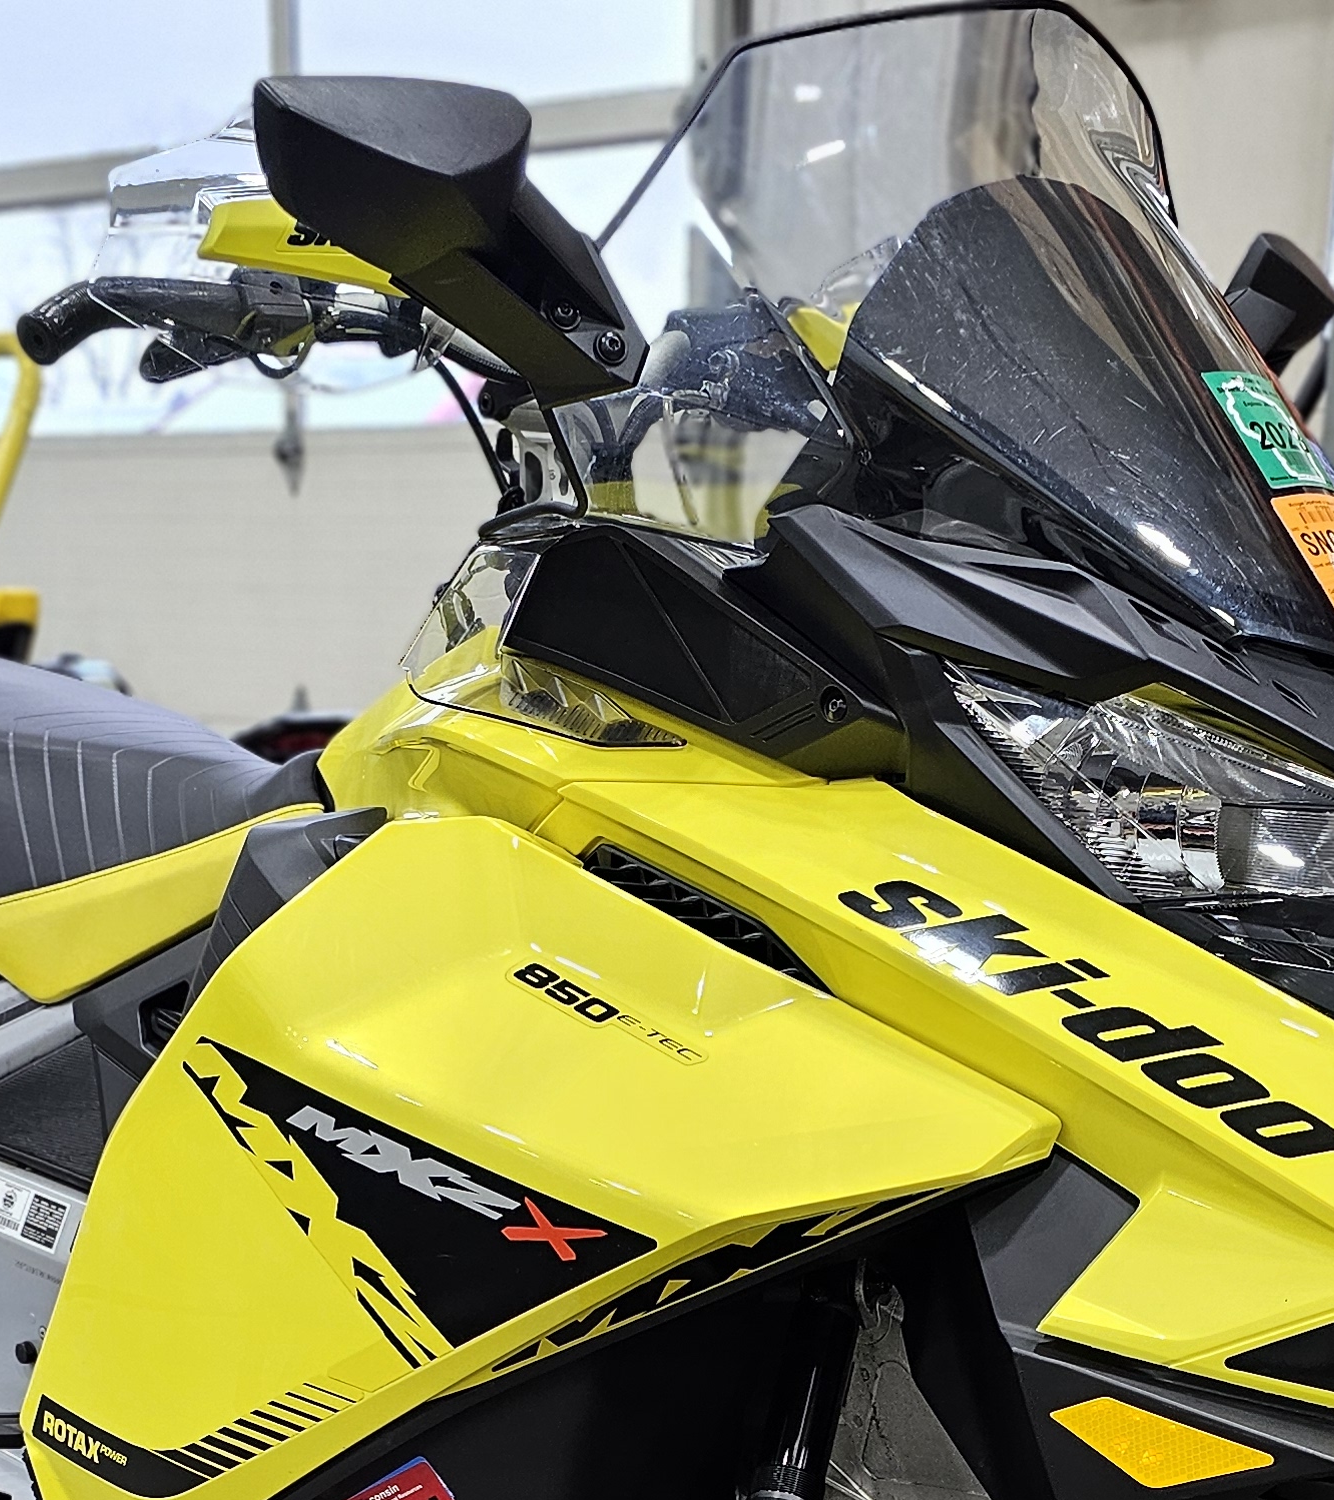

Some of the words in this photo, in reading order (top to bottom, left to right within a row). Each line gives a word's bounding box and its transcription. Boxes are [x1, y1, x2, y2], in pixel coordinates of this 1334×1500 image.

[513, 962, 621, 1024] 850
[616, 1014, 703, 1062] E-TEC
[285, 1104, 521, 1221] MXZ
[501, 1196, 607, 1262] X
[42, 1410, 101, 1465] ROTAX
[99, 1444, 129, 1468] POWER
